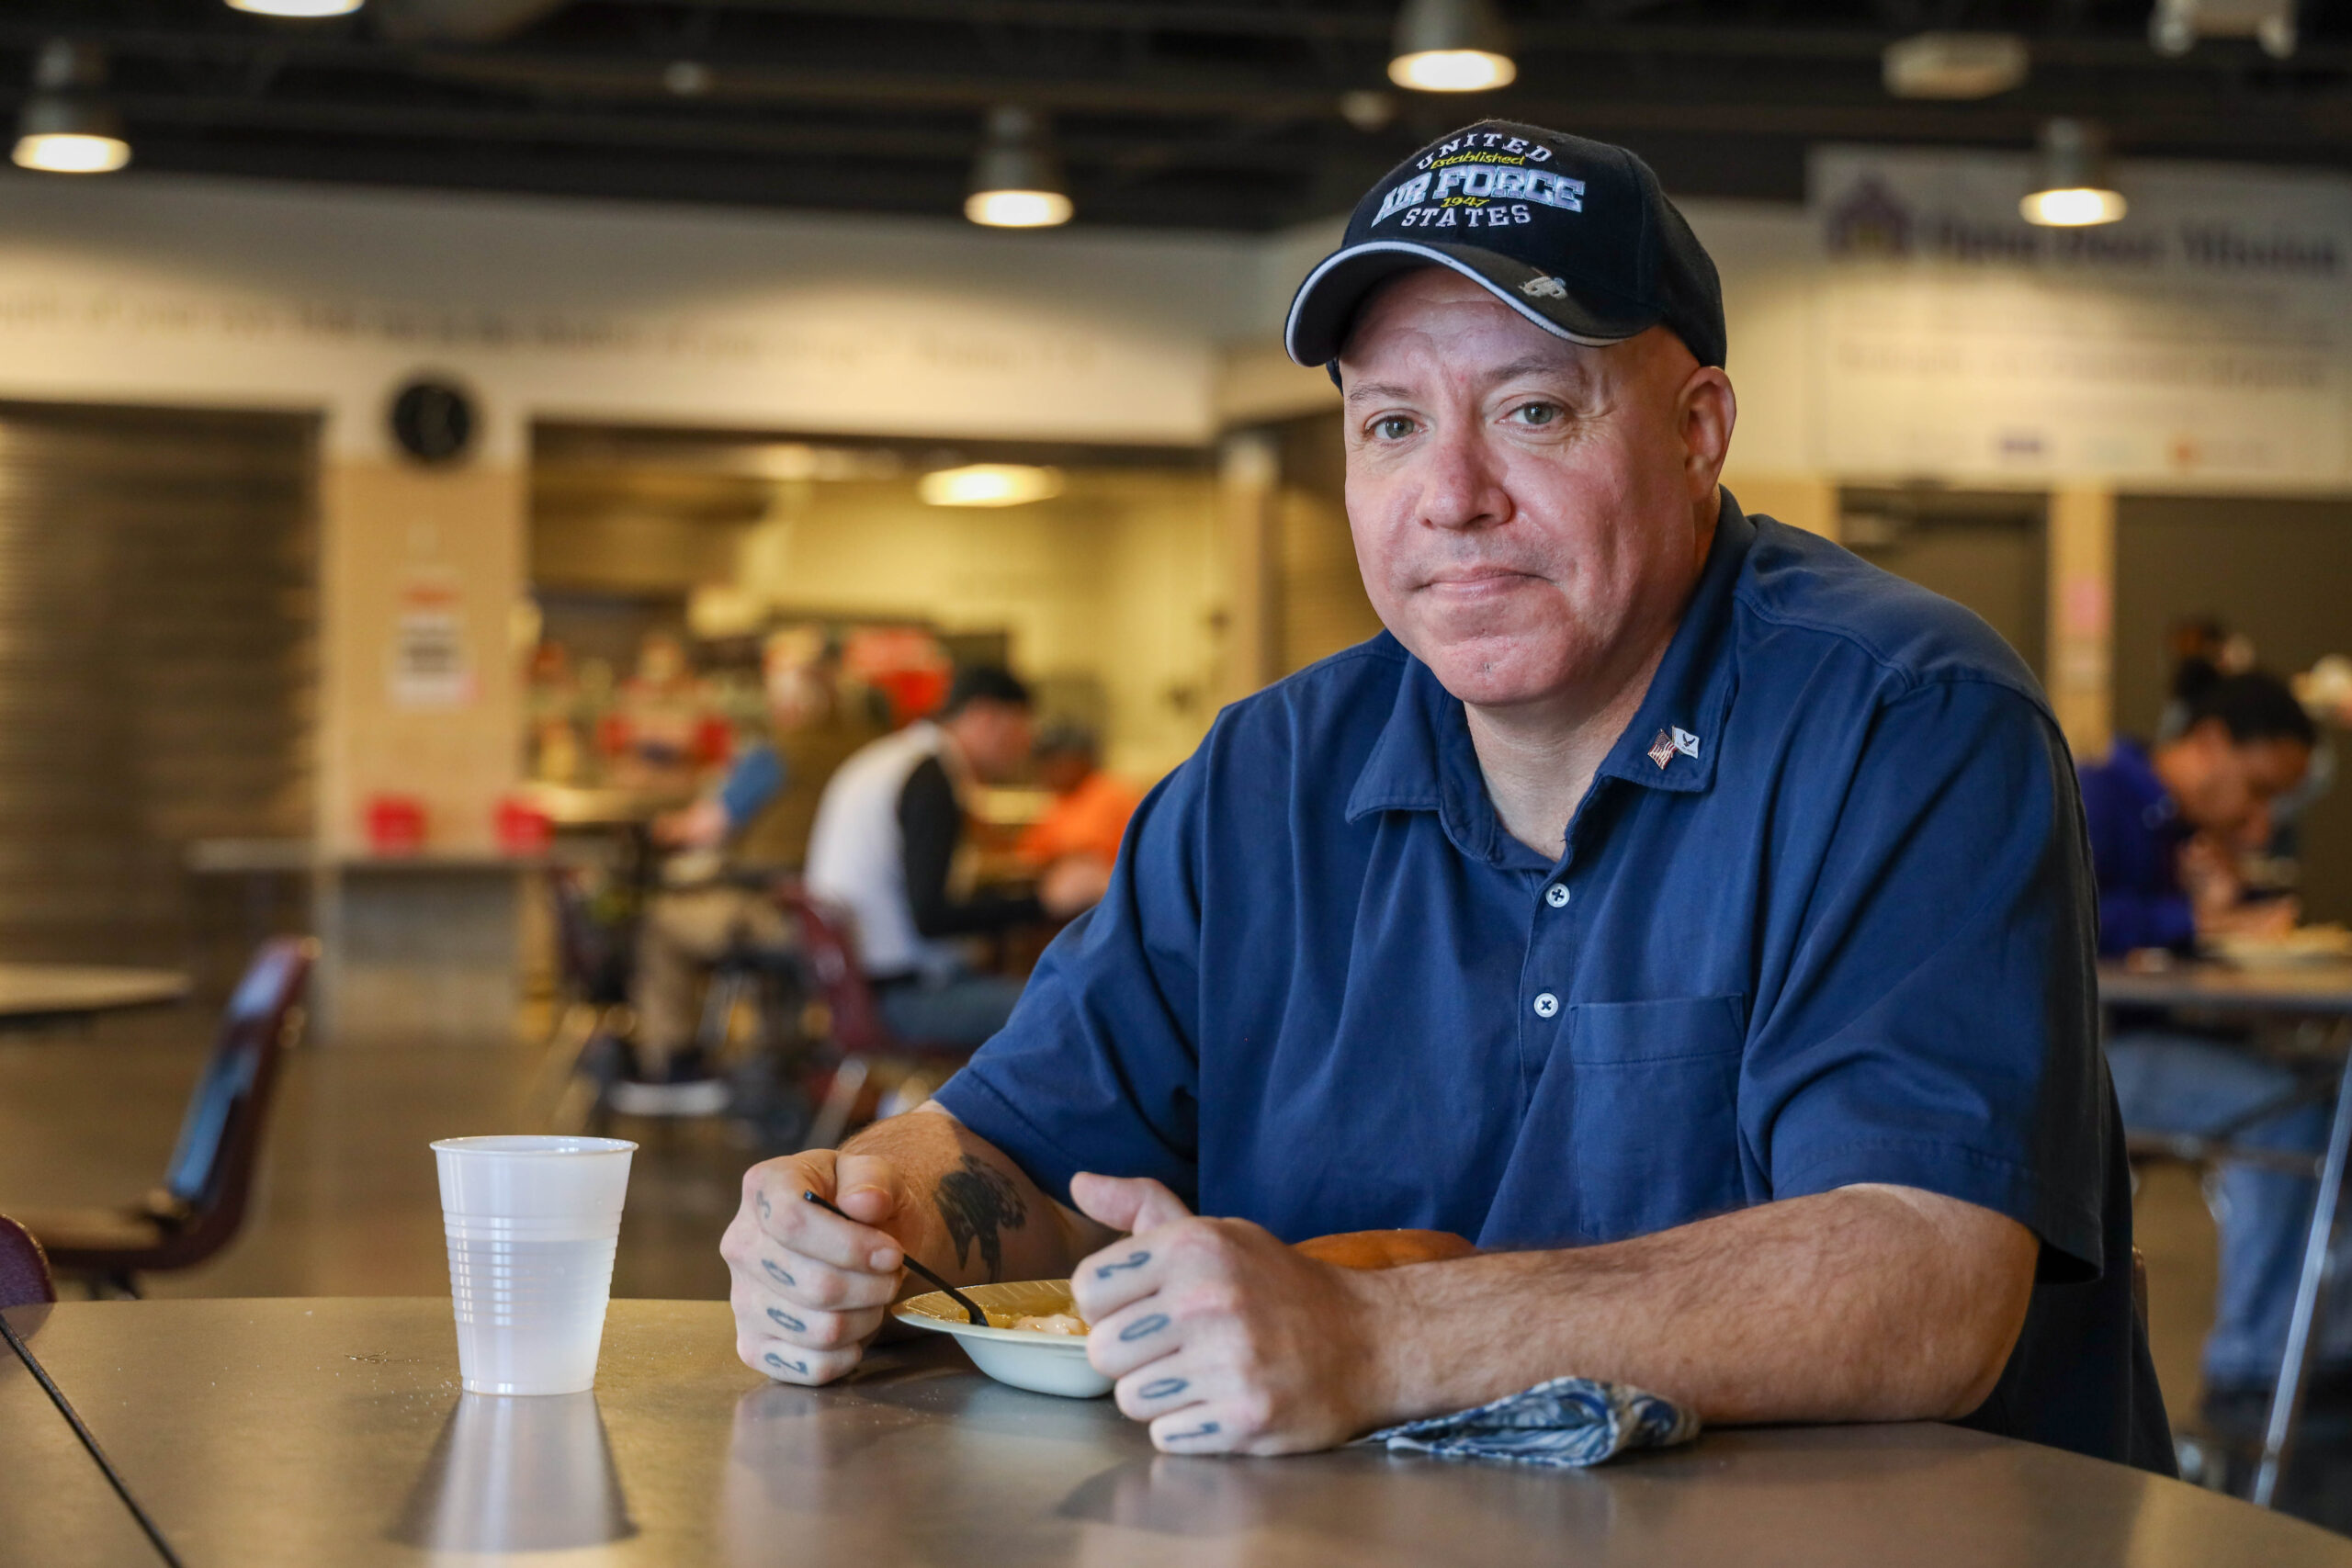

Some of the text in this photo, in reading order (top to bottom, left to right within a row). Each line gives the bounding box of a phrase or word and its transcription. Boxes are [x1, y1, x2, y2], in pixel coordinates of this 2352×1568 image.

[1416, 133, 1553, 170] UNITED
[1430, 151, 1526, 170] Established
[1371, 164, 1586, 229] AIR FORCE
[1440, 197, 1490, 209] 1947
[1400, 204, 1532, 228] STATES
